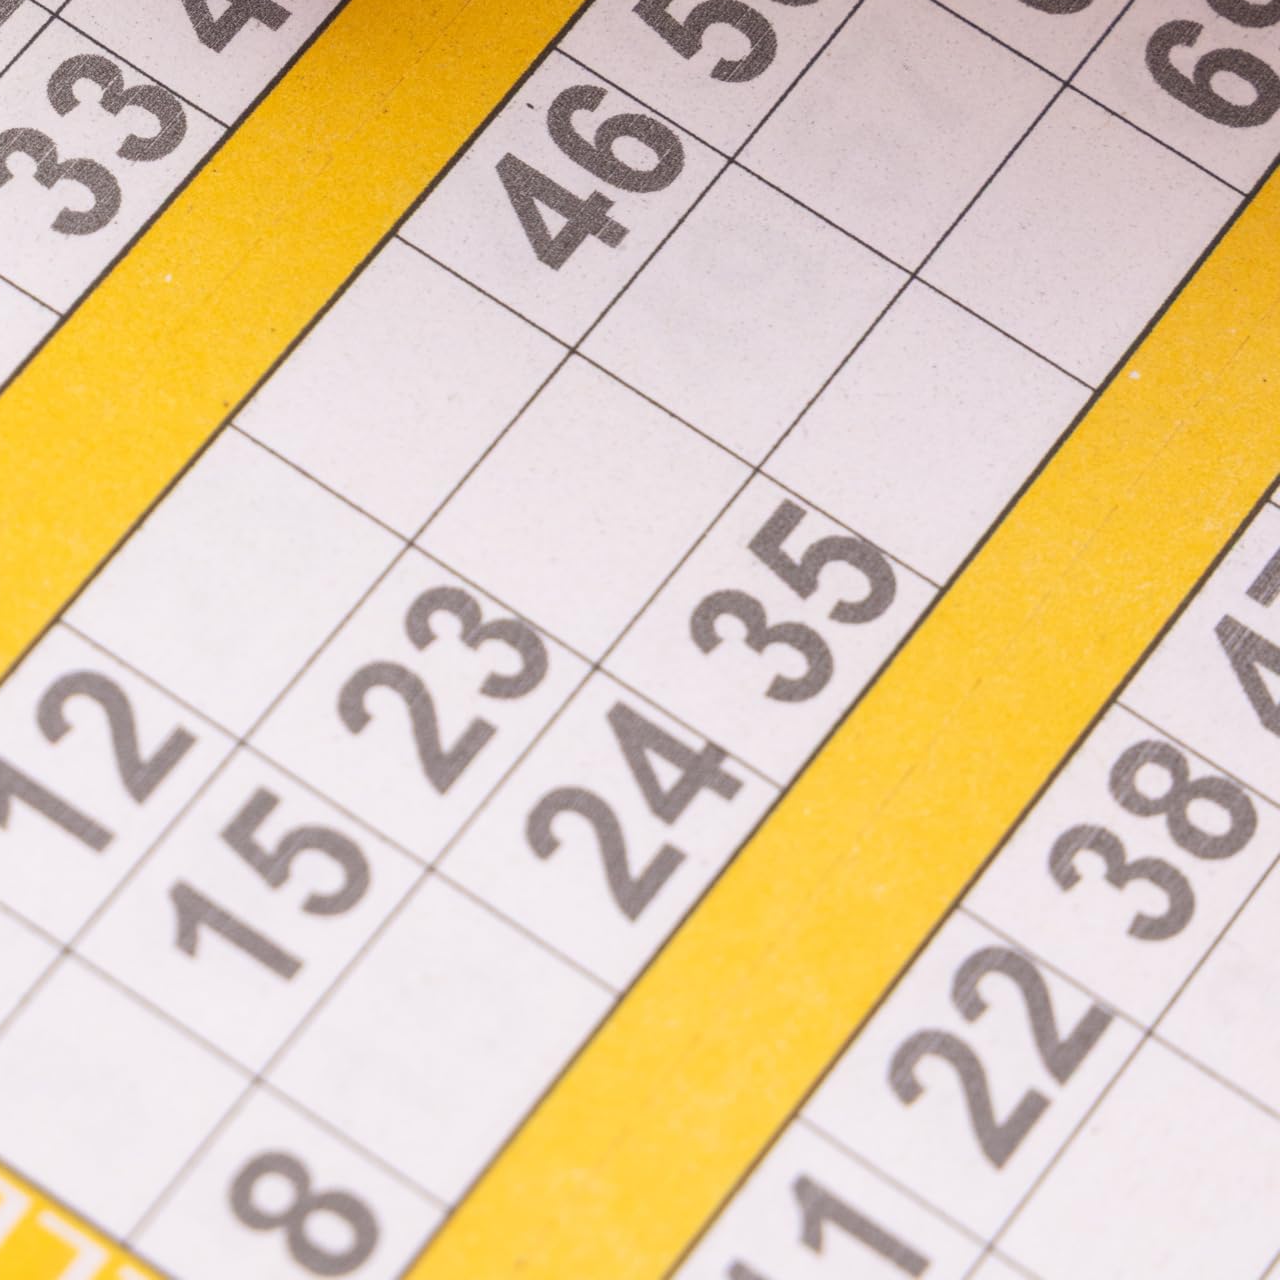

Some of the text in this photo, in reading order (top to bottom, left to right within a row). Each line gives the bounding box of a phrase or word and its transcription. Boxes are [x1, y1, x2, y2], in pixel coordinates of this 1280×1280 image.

[494, 83, 686, 272] 46
[337, 585, 549, 795] 23
[689, 498, 897, 704] 35
[167, 786, 371, 982] 15
[524, 700, 744, 922] 24
[1047, 739, 1259, 942] 38
[887, 946, 1116, 1170] 22
[228, 1150, 380, 1278] 8
